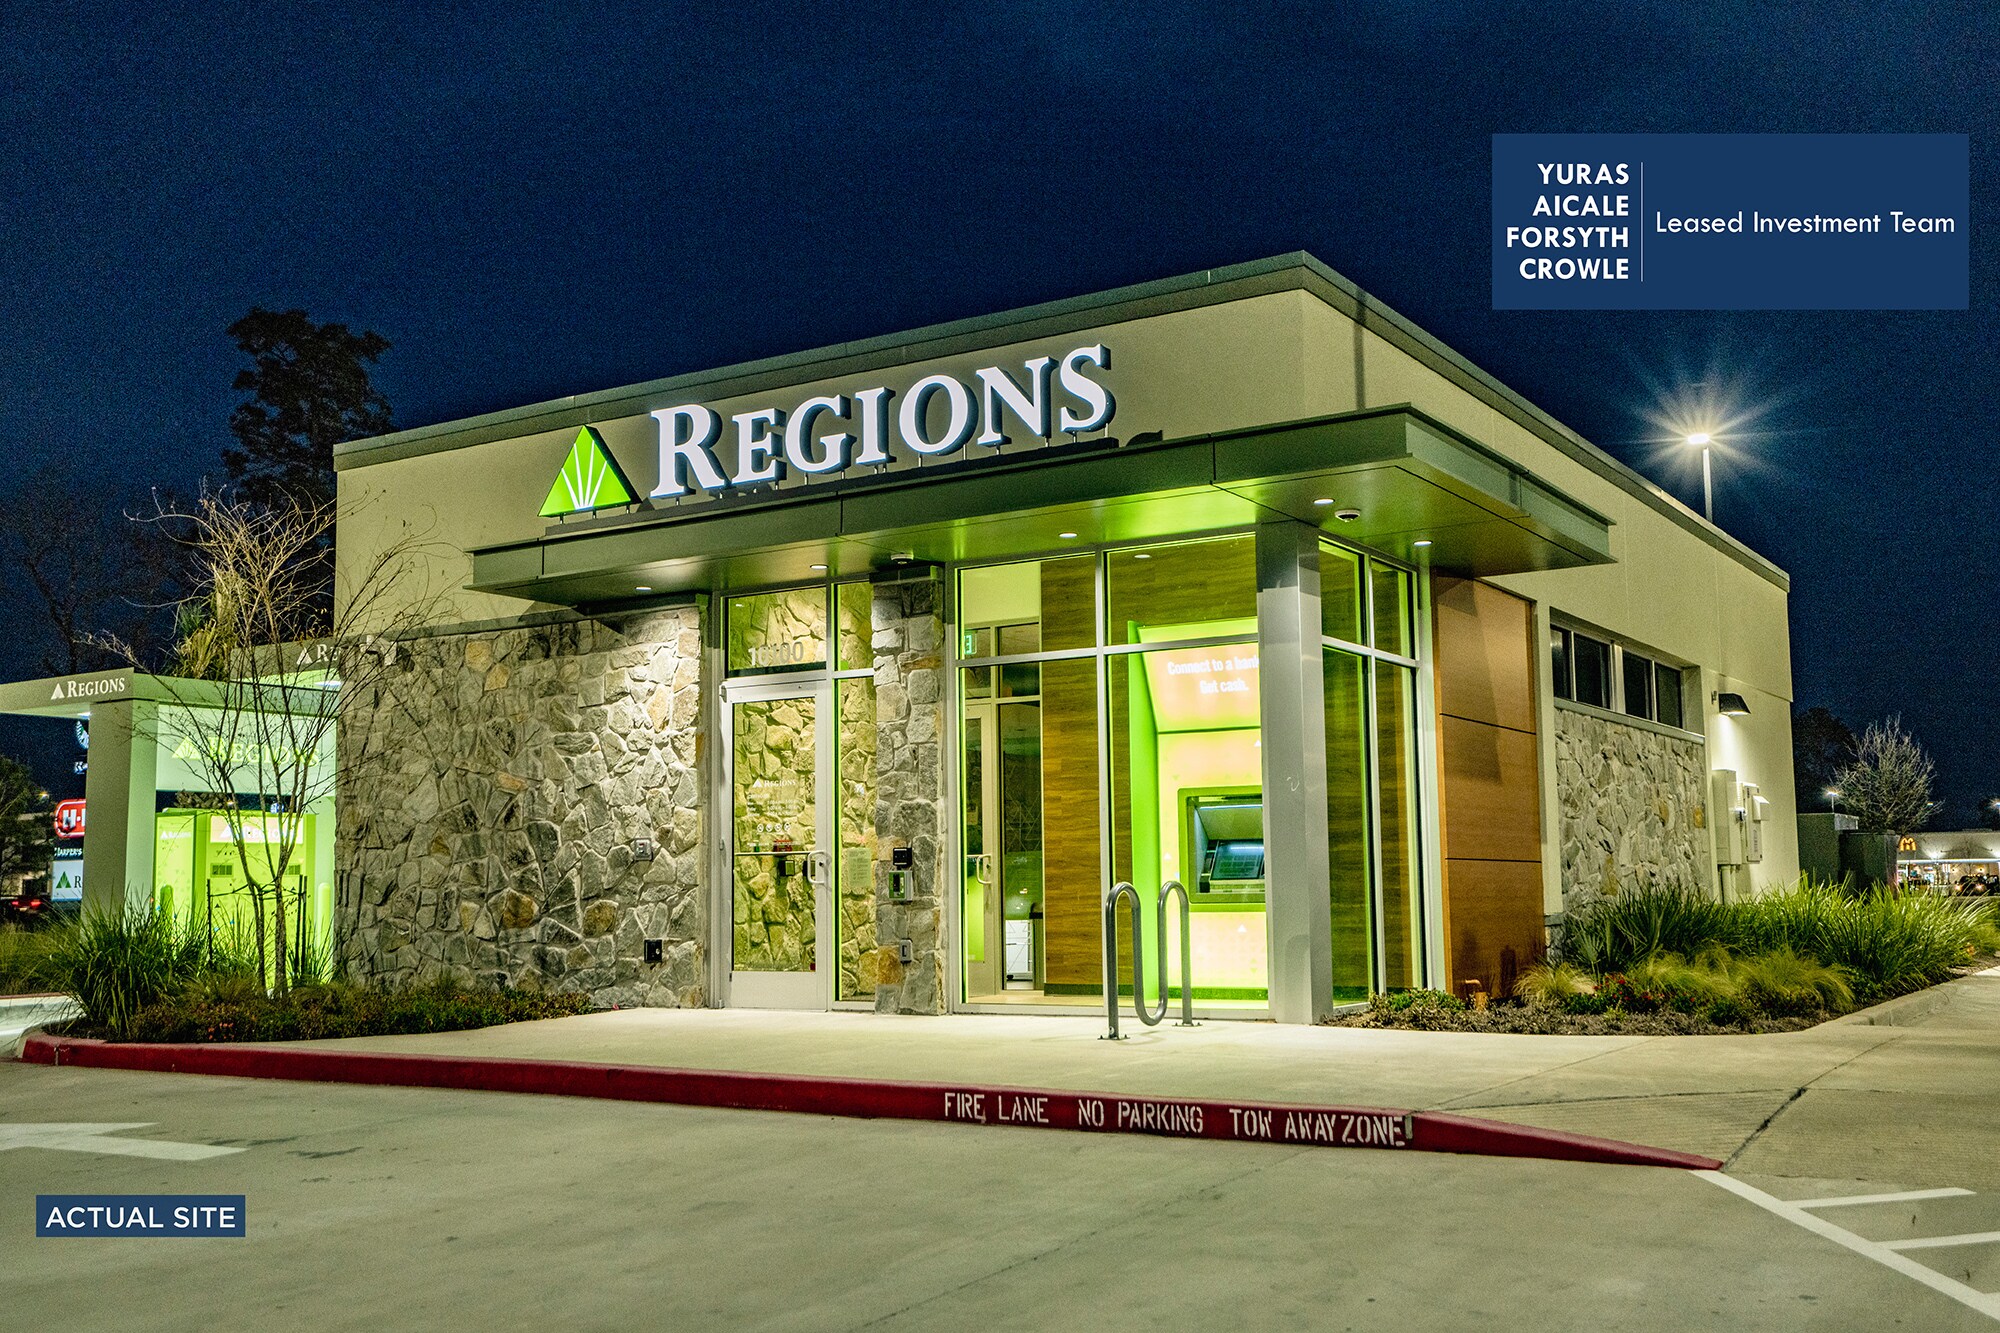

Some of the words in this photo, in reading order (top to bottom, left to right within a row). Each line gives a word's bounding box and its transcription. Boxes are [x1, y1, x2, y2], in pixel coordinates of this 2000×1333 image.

[649, 343, 1112, 499] REGIONS
[1167, 659, 1211, 675] Connect
[1211, 658, 1224, 672] to
[1225, 659, 1233, 671] a
[67, 677, 125, 698] REGIONS
[944, 1092, 985, 1120] FIRE
[998, 1095, 1049, 1123] LANE
[1078, 1099, 1104, 1127] NO
[1118, 1101, 1203, 1133] PARKING
[1229, 1108, 1272, 1138] TOW
[1284, 1111, 1337, 1142] AWAY
[1341, 1114, 1406, 1147] ZONE
